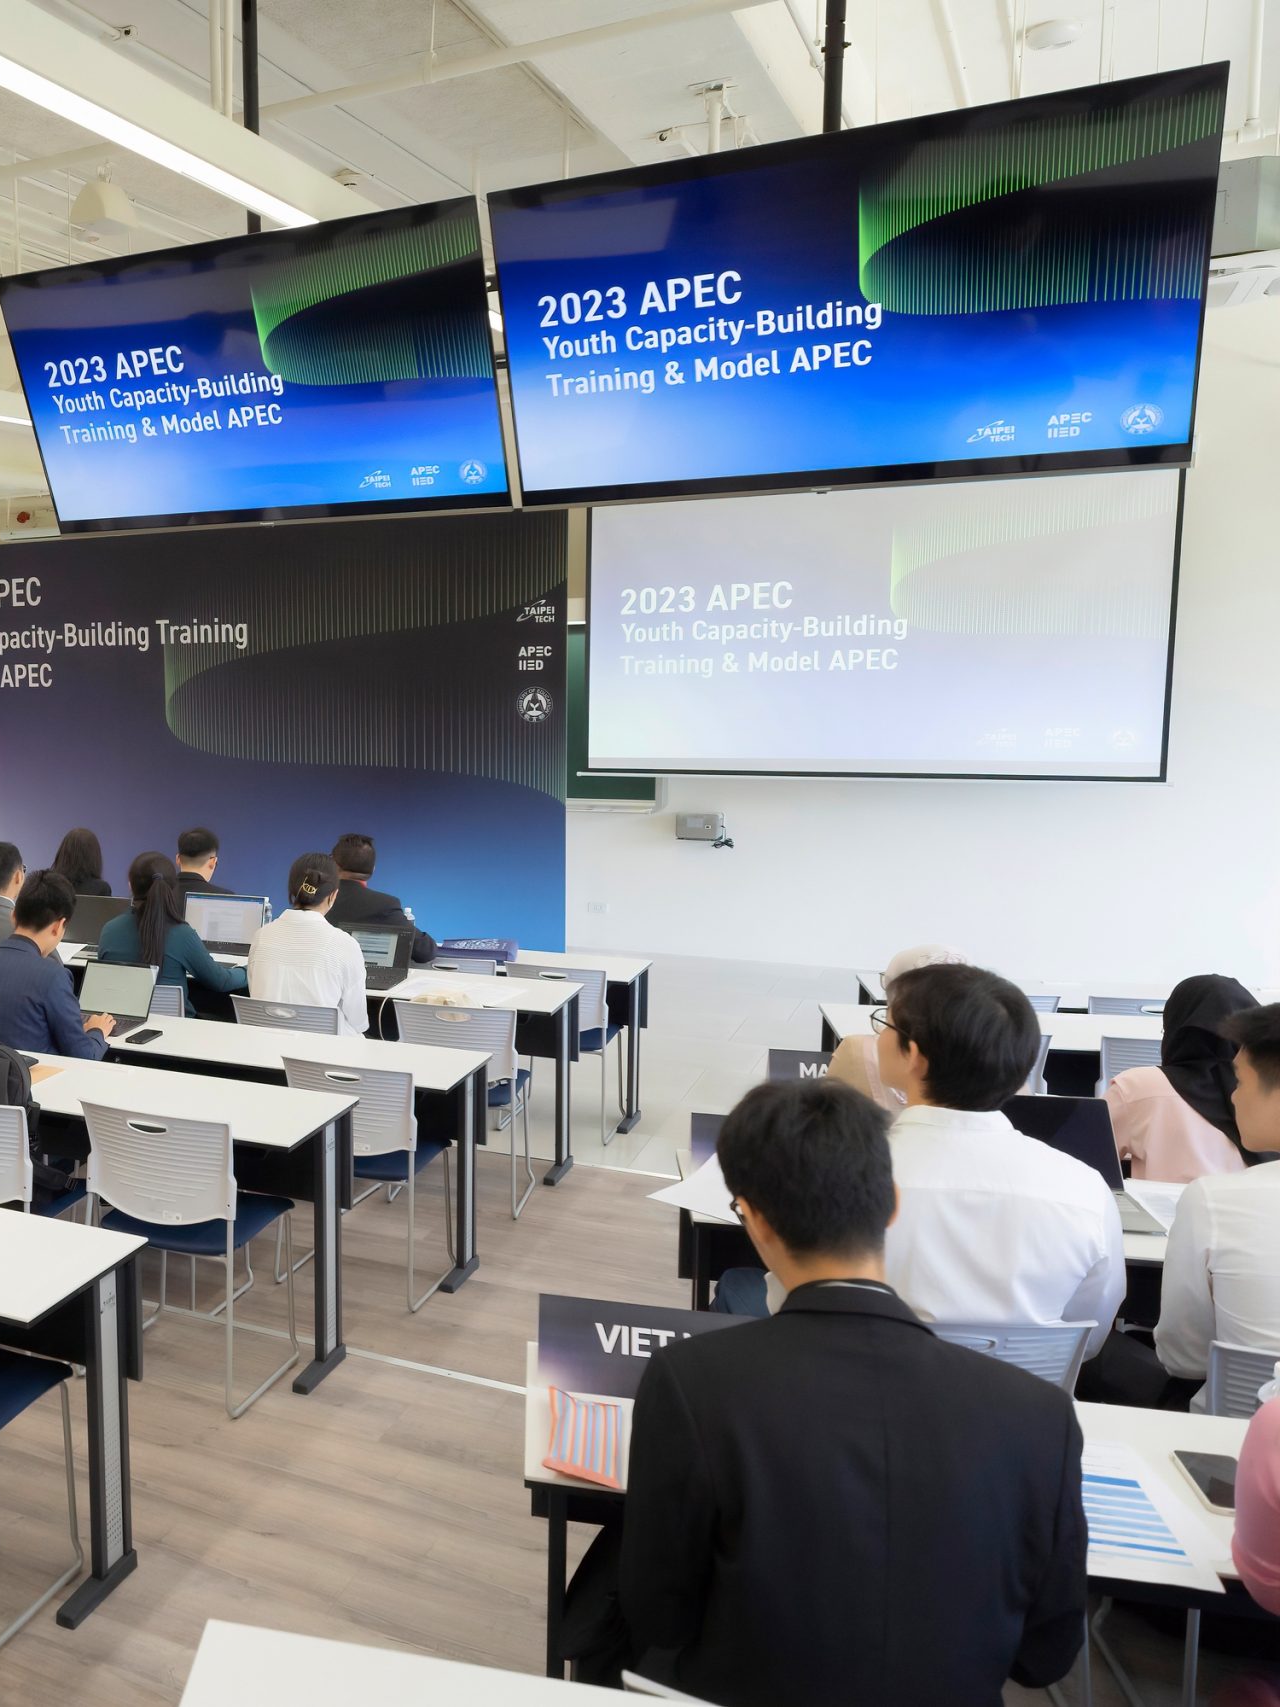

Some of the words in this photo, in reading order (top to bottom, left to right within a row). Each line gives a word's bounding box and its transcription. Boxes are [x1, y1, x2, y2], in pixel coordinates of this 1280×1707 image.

[538, 286, 627, 328] 2023
[640, 270, 742, 316] APEC
[542, 332, 616, 360] Youth
[626, 300, 883, 354] Capacity-Building
[44, 356, 107, 388] 2023
[116, 346, 184, 380] APEC
[546, 366, 655, 397] Training
[664, 360, 685, 386] &
[695, 350, 780, 383] Model
[790, 340, 872, 373] APEC
[52, 390, 105, 414] Youth
[110, 372, 283, 410] Capacity-Building
[60, 422, 137, 444] Training
[142, 417, 158, 436] &
[161, 410, 222, 435] Model
[228, 404, 282, 429] APEC
[977, 426, 1014, 436] TAIPEI
[1048, 412, 1092, 426] APEC
[1048, 426, 1080, 438] IIED
[990, 434, 1014, 442] TECH
[364, 474, 390, 482] TAIPEI
[411, 466, 440, 476] APEC
[524, 606, 555, 614] TAIPEI
[620, 586, 696, 616] 2023
[706, 580, 793, 612] APEC
[156, 617, 248, 648] Training
[622, 620, 684, 644] Youth
[692, 614, 908, 645] Capacity-Building
[518, 646, 552, 656] APEC
[518, 660, 544, 670] IIED
[620, 654, 713, 678] Training
[722, 652, 739, 672] &
[748, 651, 820, 672] Model
[828, 648, 898, 671] APEC
[0, 663, 52, 688] APEC
[594, 1322, 676, 1358] VIET
